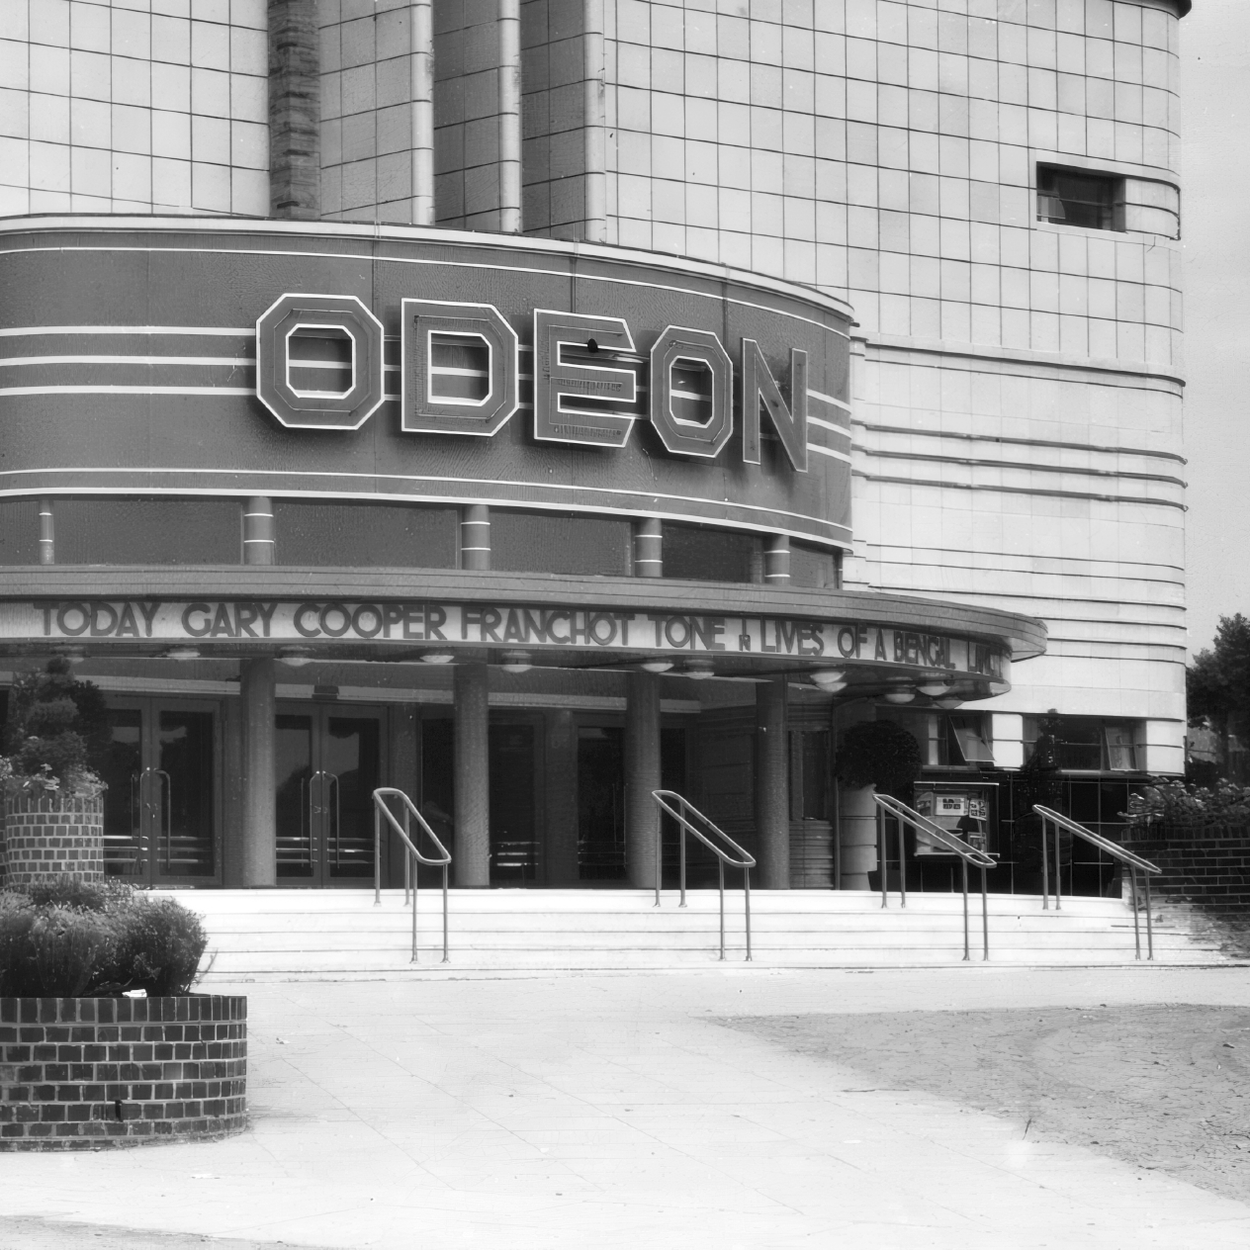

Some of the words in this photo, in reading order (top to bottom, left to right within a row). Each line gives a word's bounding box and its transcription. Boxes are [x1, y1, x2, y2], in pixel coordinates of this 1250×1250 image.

[255, 292, 809, 473] ODEON
[35, 601, 163, 638] TODAY
[181, 602, 278, 639] GARY
[293, 603, 448, 641] COOPER
[460, 606, 636, 648] FRANCHOT
[649, 612, 726, 652] TONE
[759, 617, 825, 657] LIVES
[837, 622, 868, 659] OF
[875, 627, 888, 661] A
